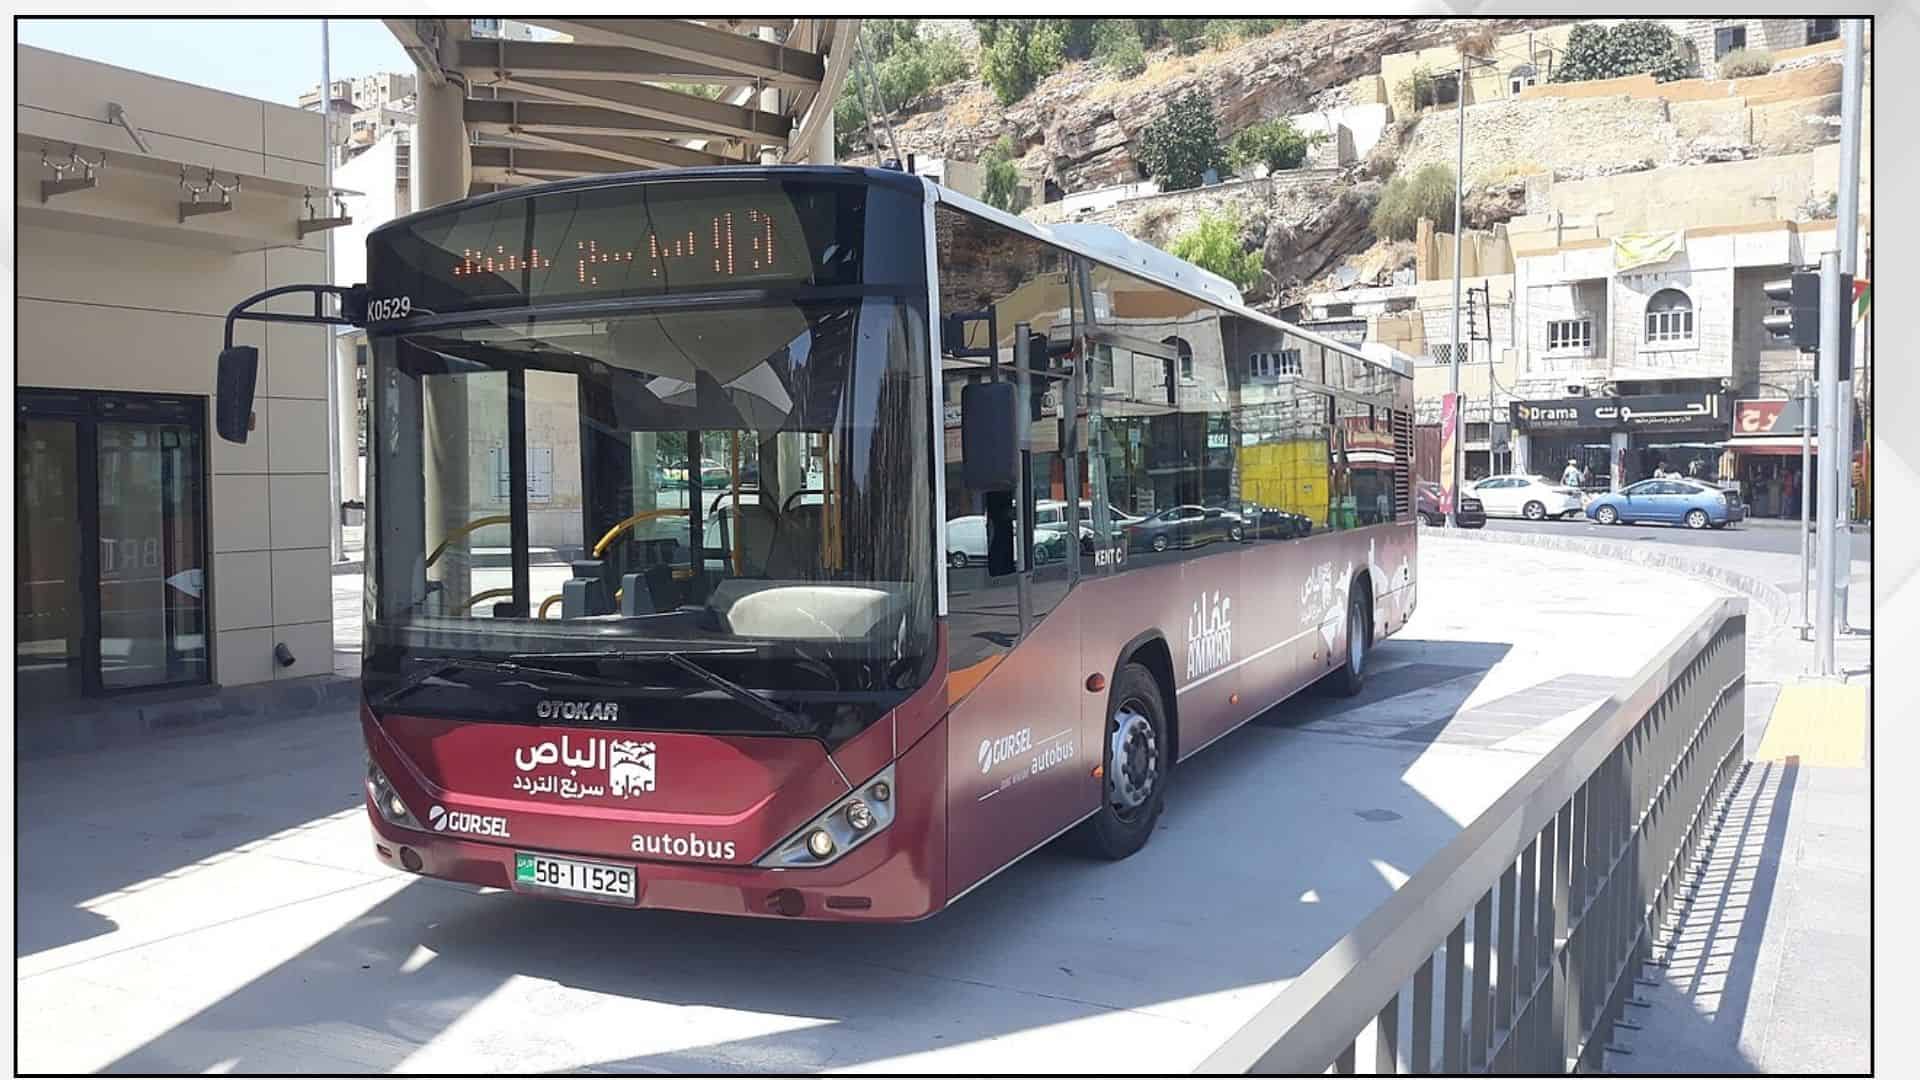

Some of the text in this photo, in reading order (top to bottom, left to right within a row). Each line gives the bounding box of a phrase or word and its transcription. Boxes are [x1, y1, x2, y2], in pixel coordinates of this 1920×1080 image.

[367, 296, 411, 322] K0529
[1531, 407, 1577, 419] Drama
[1095, 547, 1122, 567] KENT C
[537, 701, 620, 721] OTOKAR
[515, 735, 606, 776] الباص
[1031, 742, 1073, 774] autobus
[513, 775, 604, 798] سريع التردد
[631, 833, 736, 860] autobus
